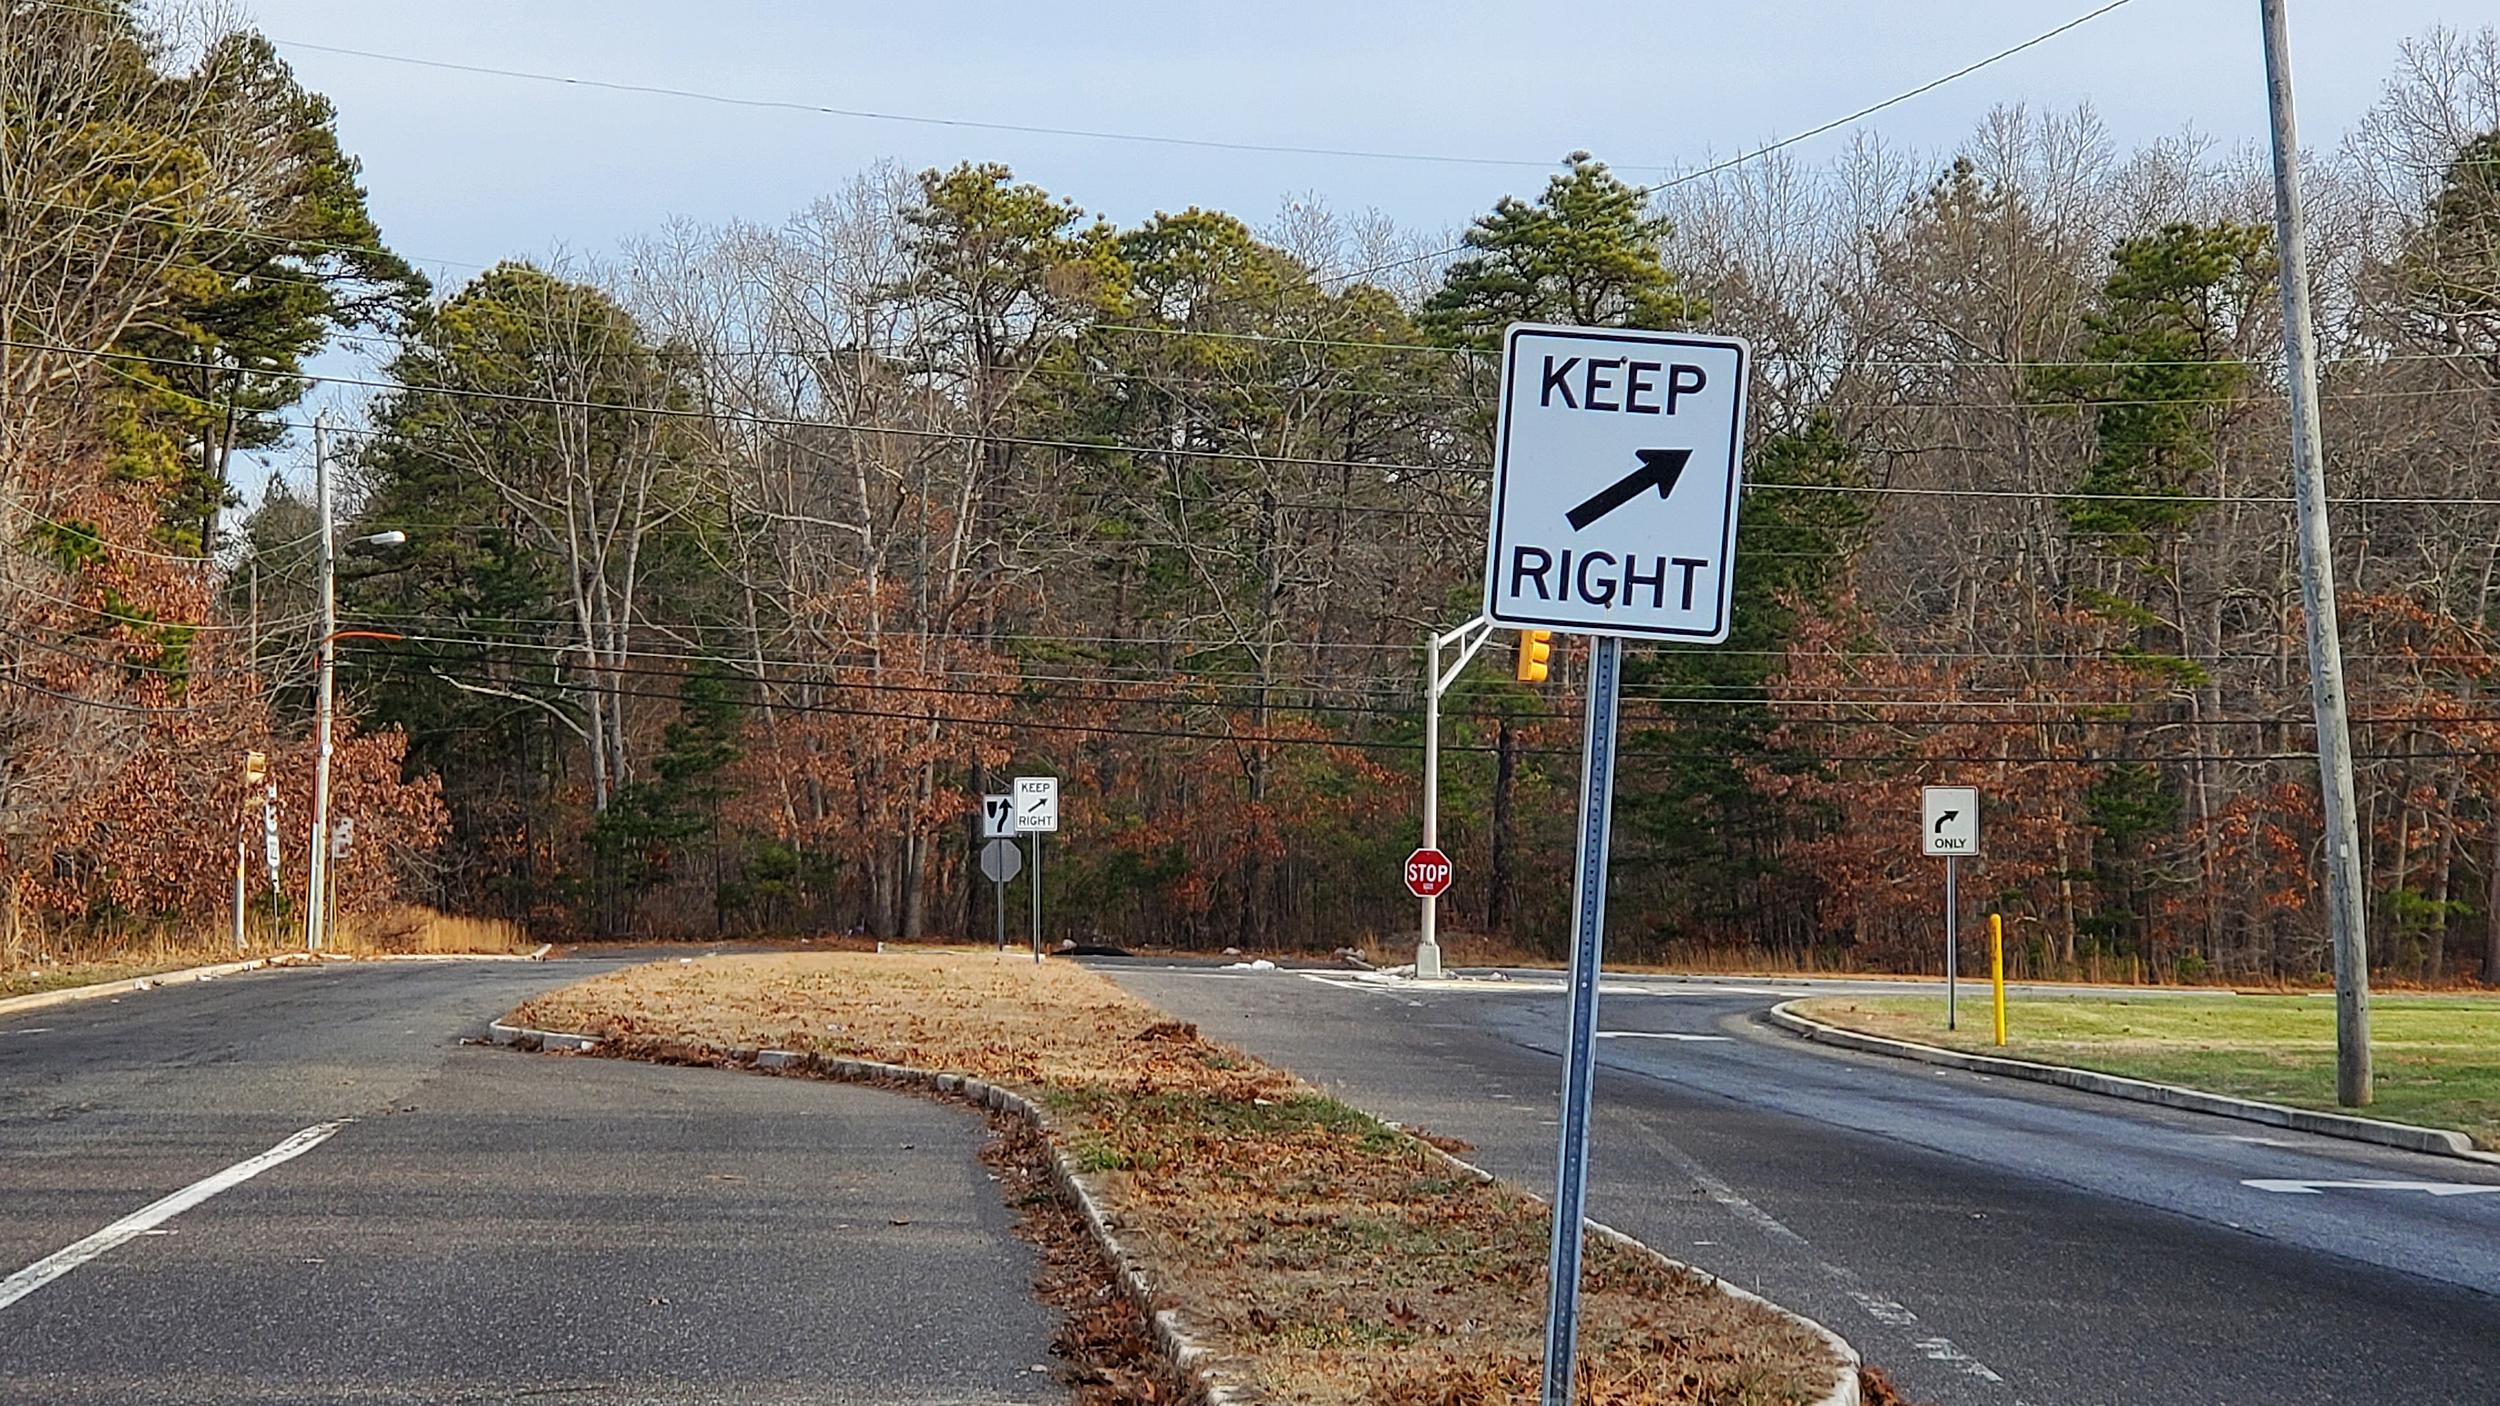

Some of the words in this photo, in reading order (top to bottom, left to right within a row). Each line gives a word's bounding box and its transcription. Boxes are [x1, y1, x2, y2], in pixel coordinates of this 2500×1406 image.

[1540, 355, 1707, 416] KEEP
[1510, 545, 1709, 611] RIGHT
[1021, 782, 1051, 793] KEEP
[1019, 815, 1052, 826] RIGHT
[1934, 838, 1967, 849] ONLY
[1408, 863, 1448, 882] STOP
